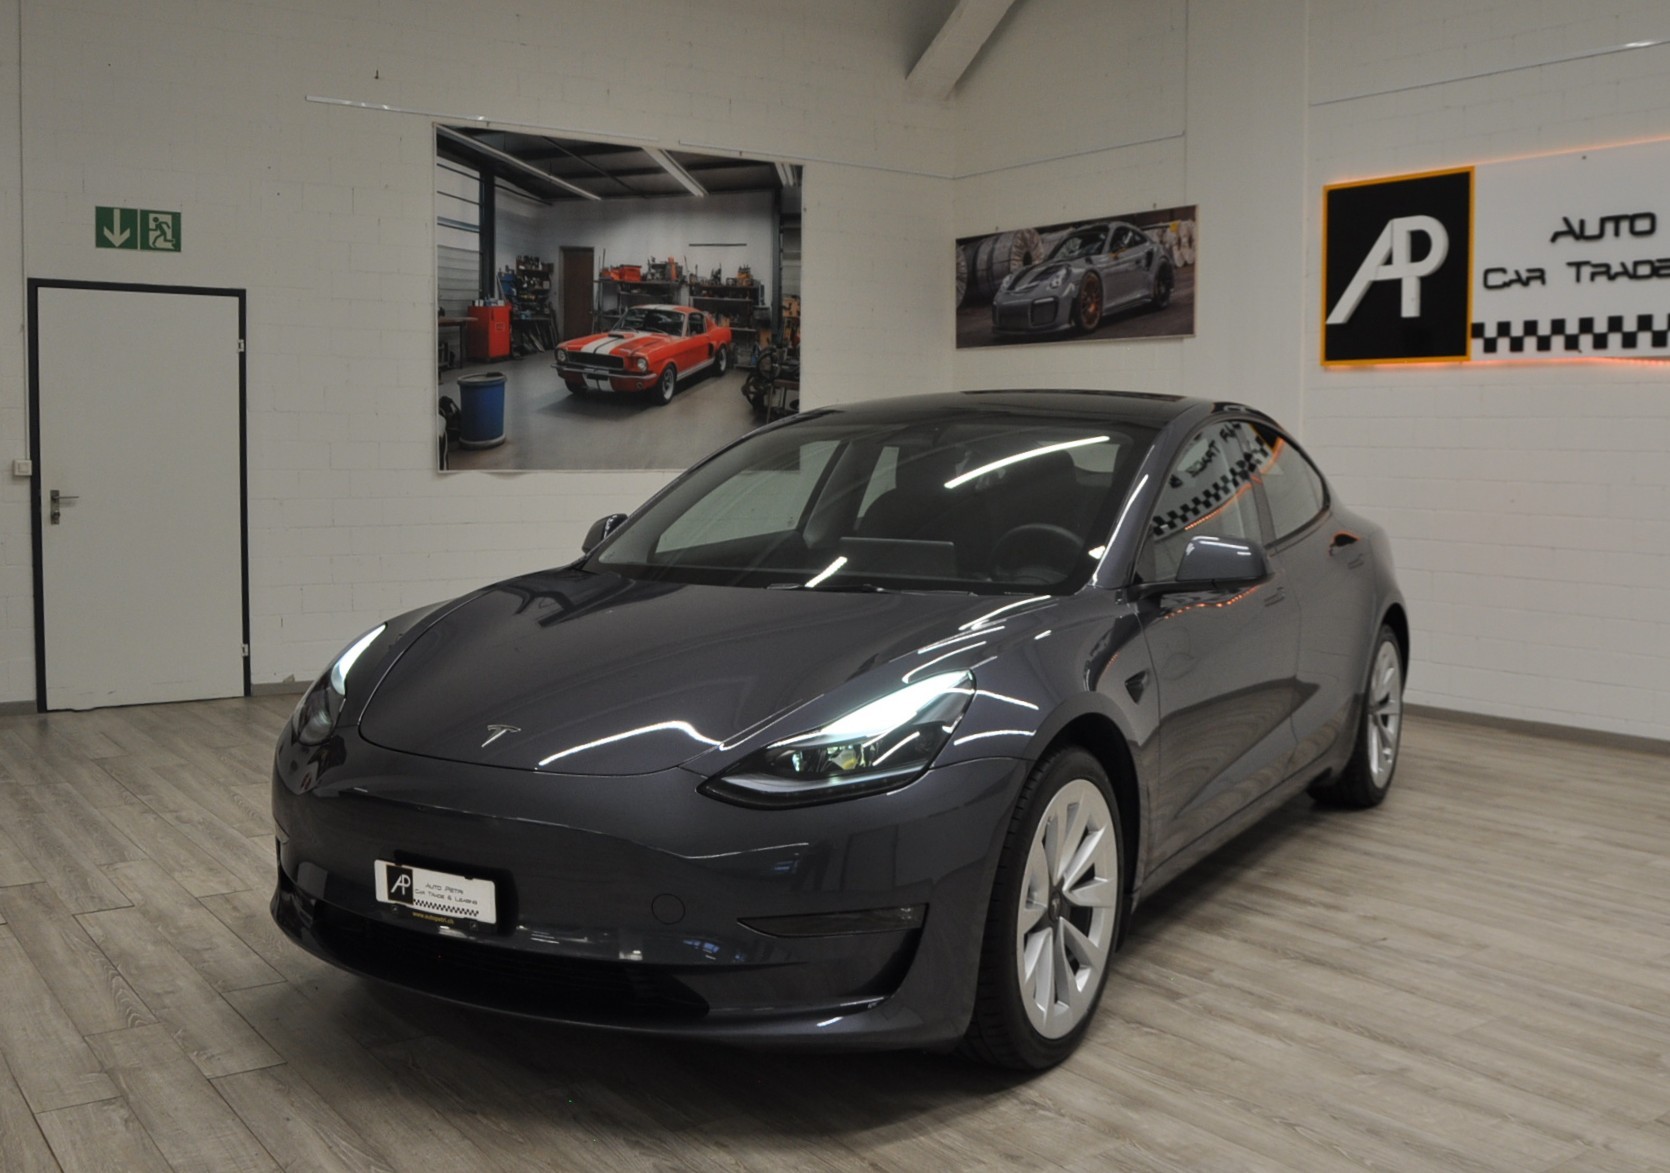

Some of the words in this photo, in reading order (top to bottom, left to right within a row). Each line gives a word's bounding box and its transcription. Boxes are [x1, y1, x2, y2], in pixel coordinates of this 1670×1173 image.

[1550, 212, 1656, 243] AUTO
[1325, 215, 1449, 325] AP
[1483, 267, 1546, 290] CAR
[425, 882, 443, 891] AUTO
